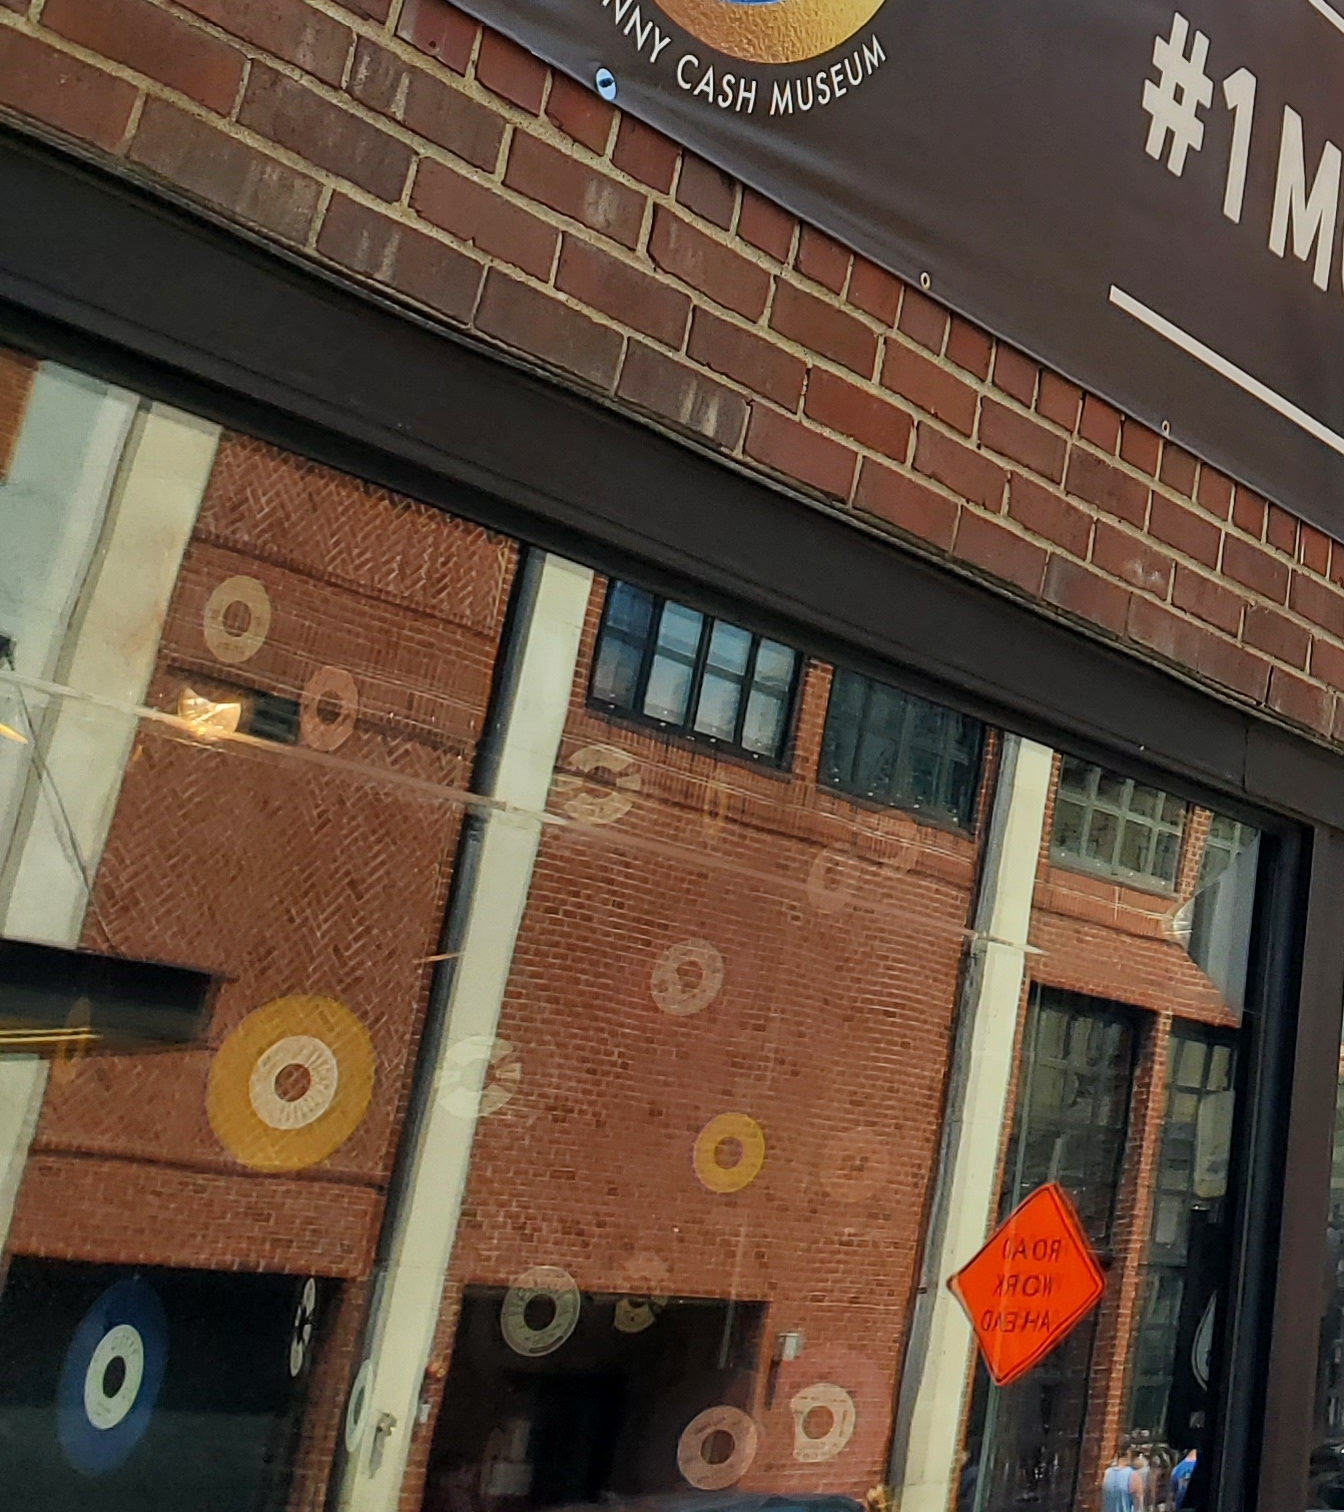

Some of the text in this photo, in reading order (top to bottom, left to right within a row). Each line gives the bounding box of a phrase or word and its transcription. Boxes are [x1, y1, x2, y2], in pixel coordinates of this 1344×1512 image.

[676, 54, 757, 115] CASH
[770, 35, 888, 117] MUSEUM
[1141, 11, 1258, 223] #1
